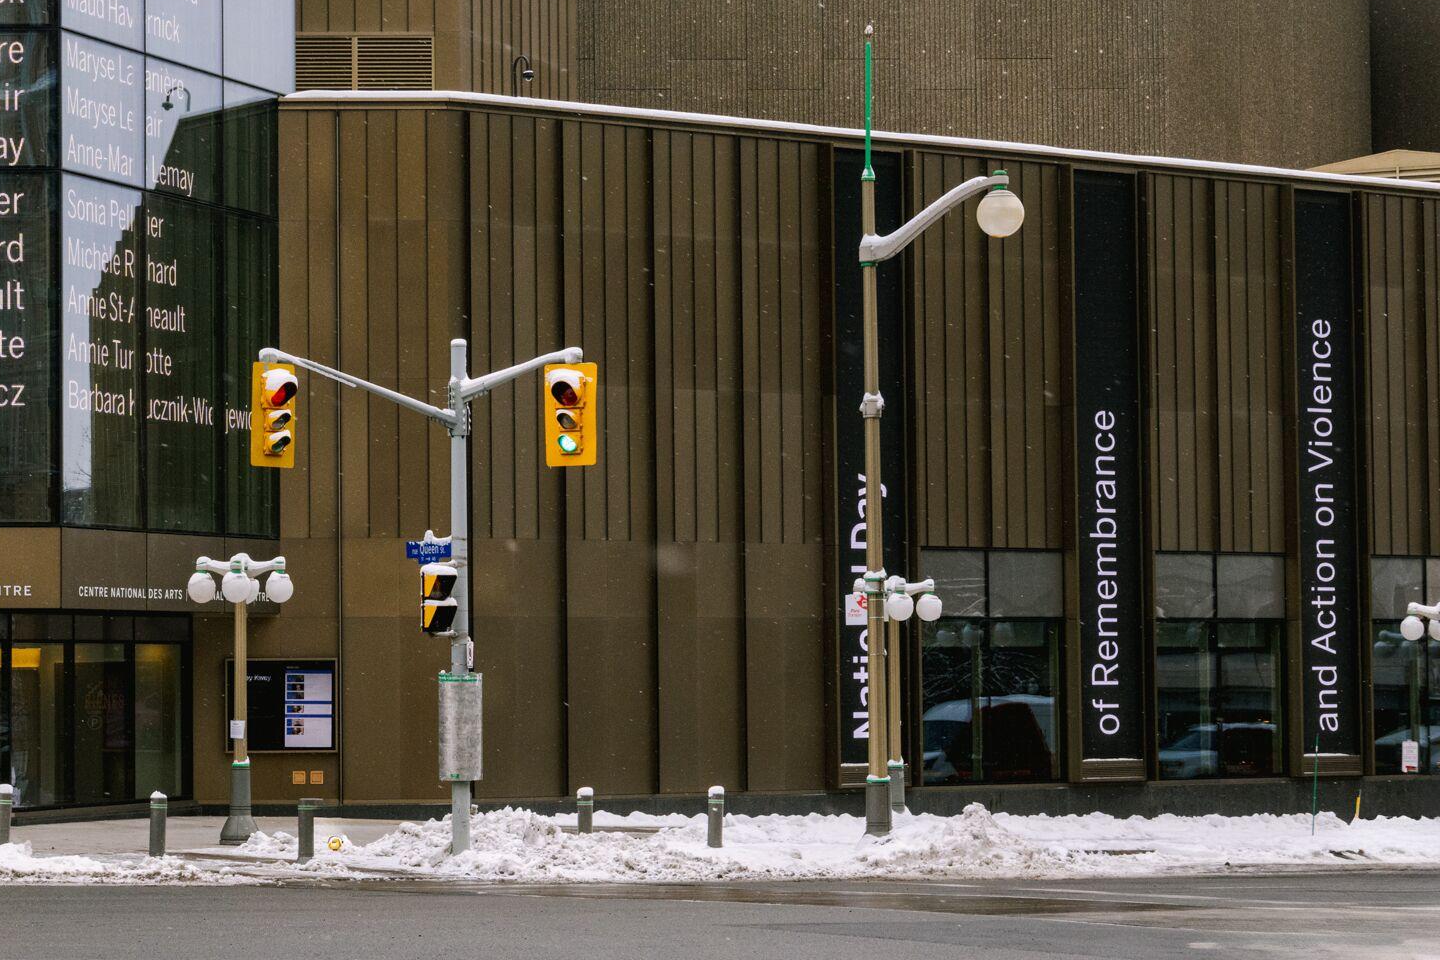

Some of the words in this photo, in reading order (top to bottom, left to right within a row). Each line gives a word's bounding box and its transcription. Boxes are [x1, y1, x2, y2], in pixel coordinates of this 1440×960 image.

[67, 40, 115, 82] Maryse
[119, 55, 185, 100] Laanière
[67, 86, 116, 129] Maryse
[120, 102, 162, 138] Leair
[67, 134, 133, 177] Anne-Mar
[152, 155, 194, 197] Lemay
[67, 189, 106, 226] Sonia
[110, 200, 164, 238] Pellier
[68, 237, 121, 276] Michèle
[125, 249, 177, 287] Rhard
[68, 285, 107, 319] Annie
[109, 292, 186, 333] St-Aneault
[68, 332, 109, 367] Annie
[113, 340, 173, 376] Turotte
[68, 380, 125, 416] Barbara
[1307, 318, 1333, 472] Violence
[1315, 482, 1335, 527] on
[420, 544, 439, 556] Queen
[1089, 409, 1120, 686] Remembrance
[78, 586, 109, 598] CENTRE
[110, 587, 147, 599] NATIONAL
[148, 588, 163, 600] DES
[164, 589, 183, 600] ARTS
[1311, 540, 1337, 654] Action
[1092, 699, 1121, 735] of
[1312, 665, 1338, 732] and
